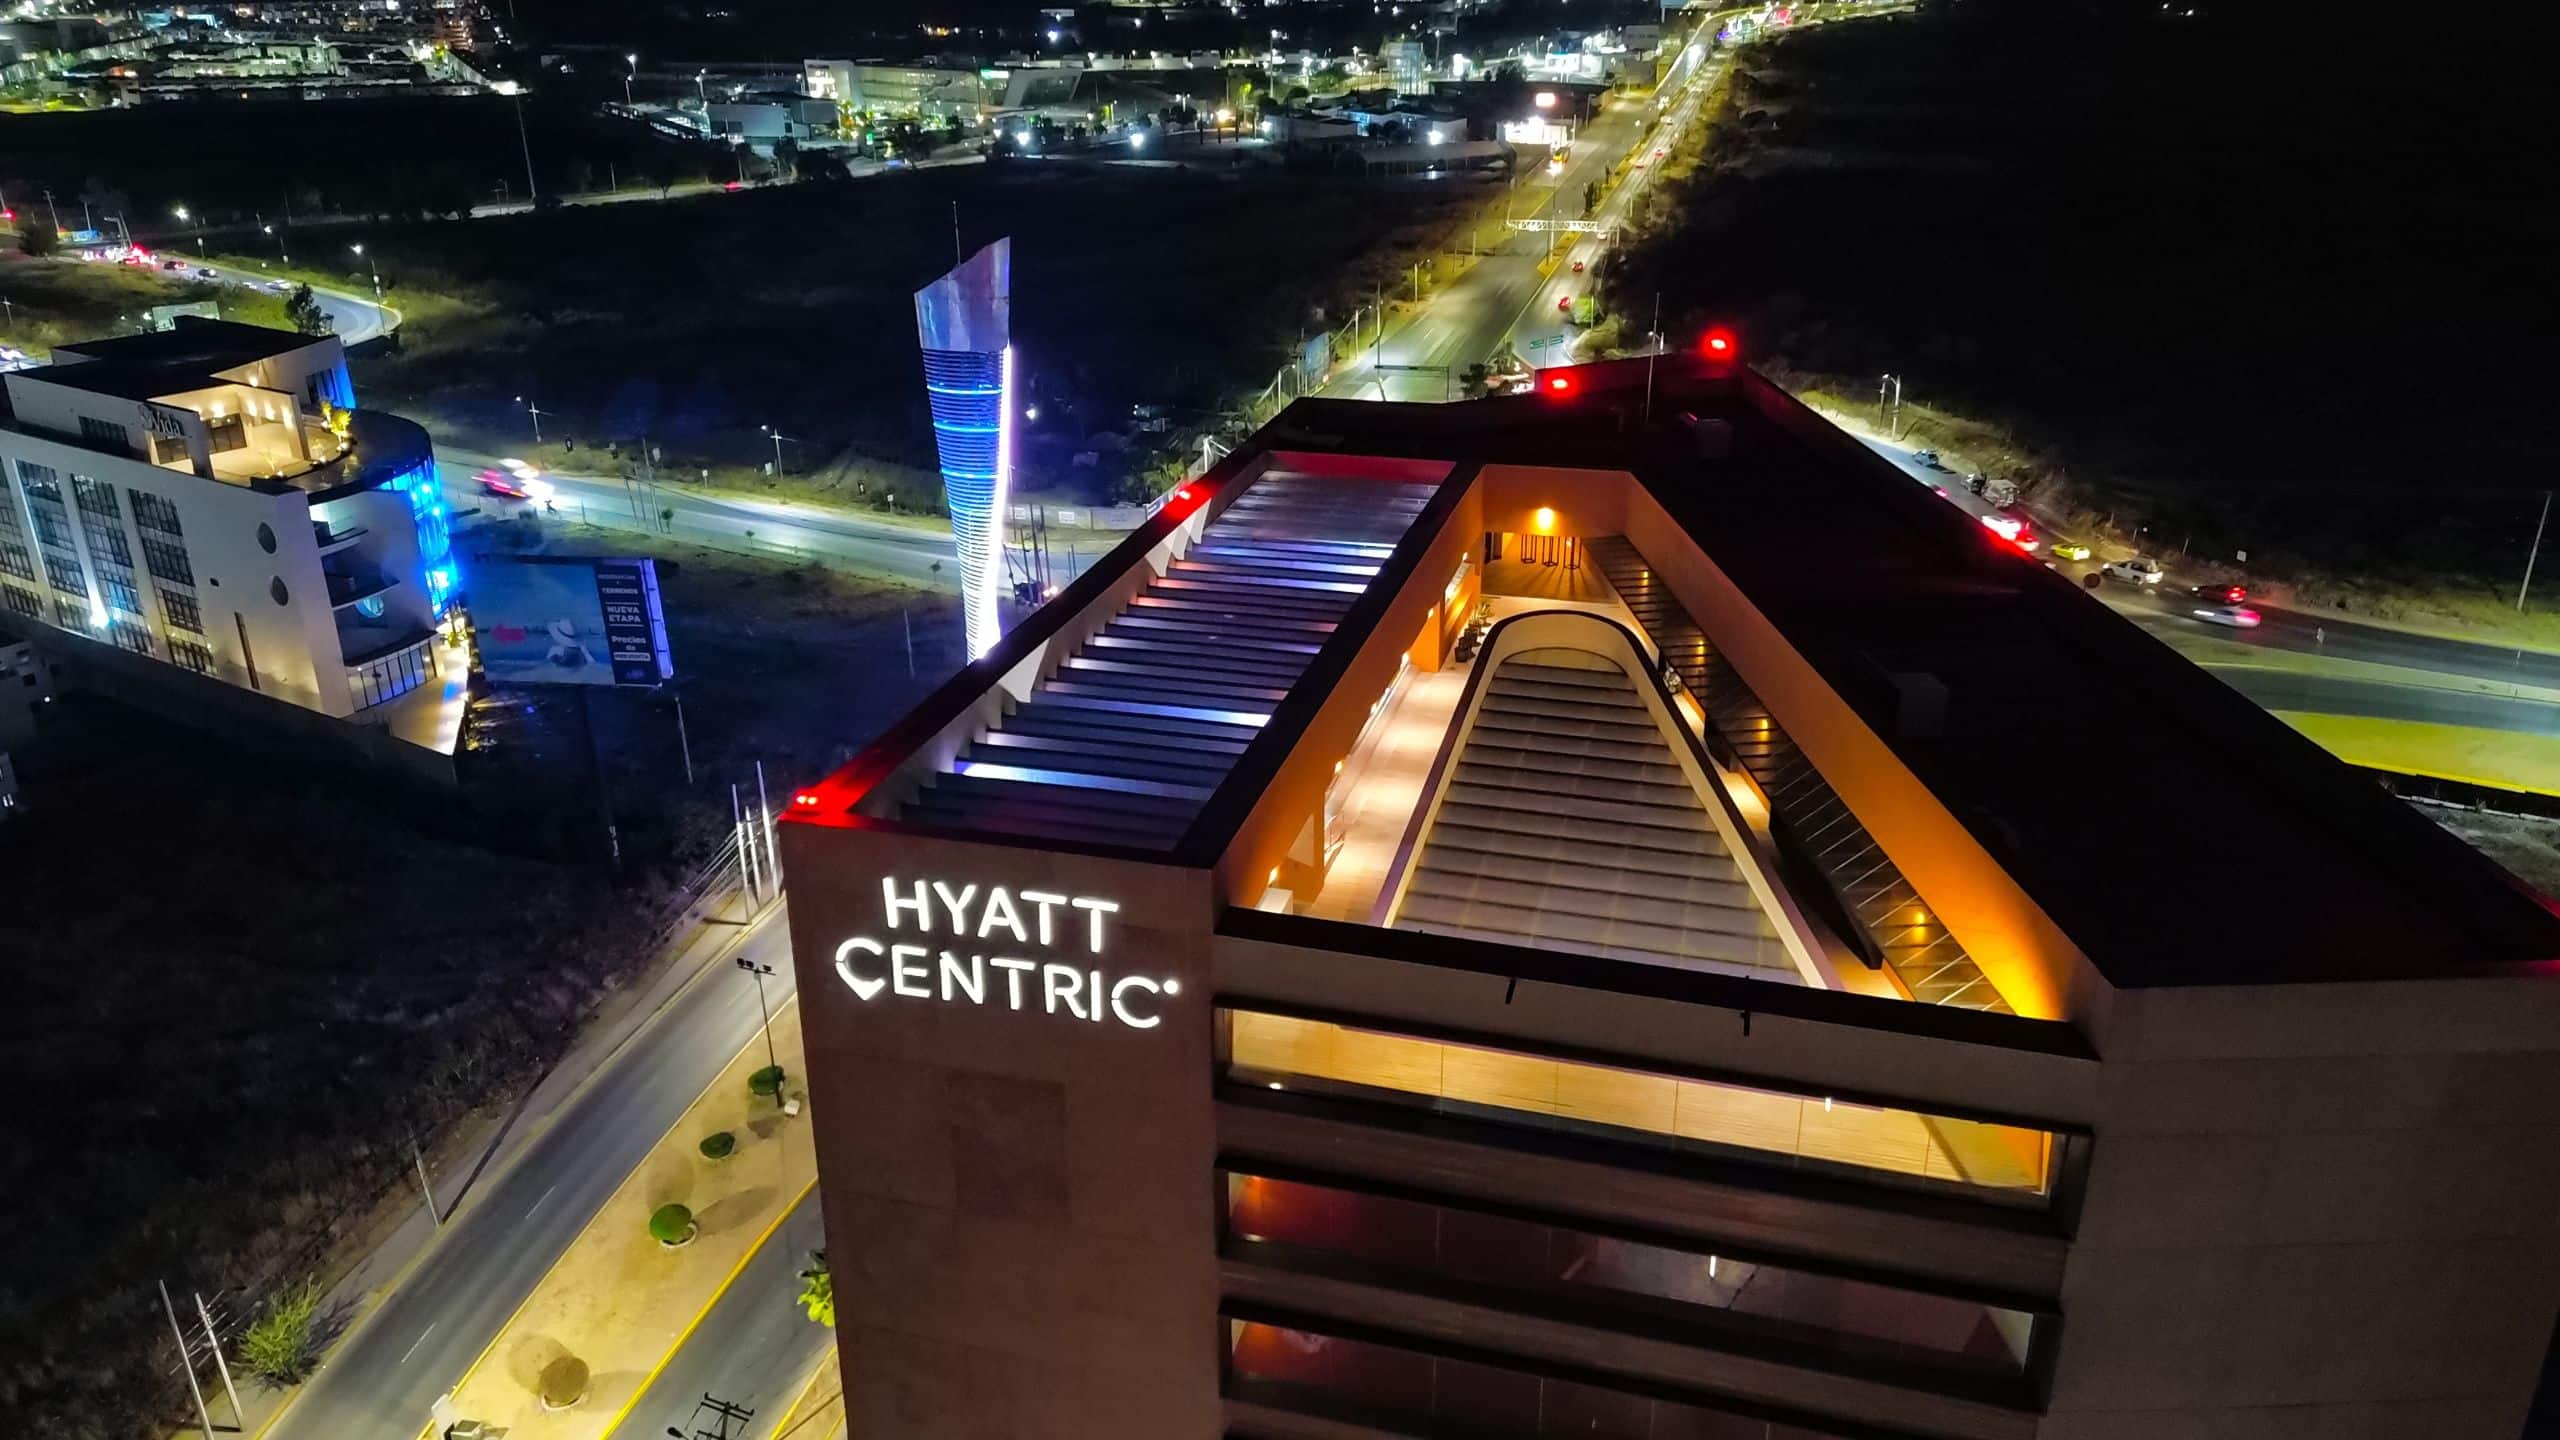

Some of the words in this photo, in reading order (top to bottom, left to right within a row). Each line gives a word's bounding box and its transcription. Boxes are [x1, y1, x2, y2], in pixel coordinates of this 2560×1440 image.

[607, 606, 640, 614] NUEVA
[609, 615, 641, 623] ETAPA
[882, 876, 1120, 953] HYATT
[835, 936, 1161, 1029] CENTRIC
